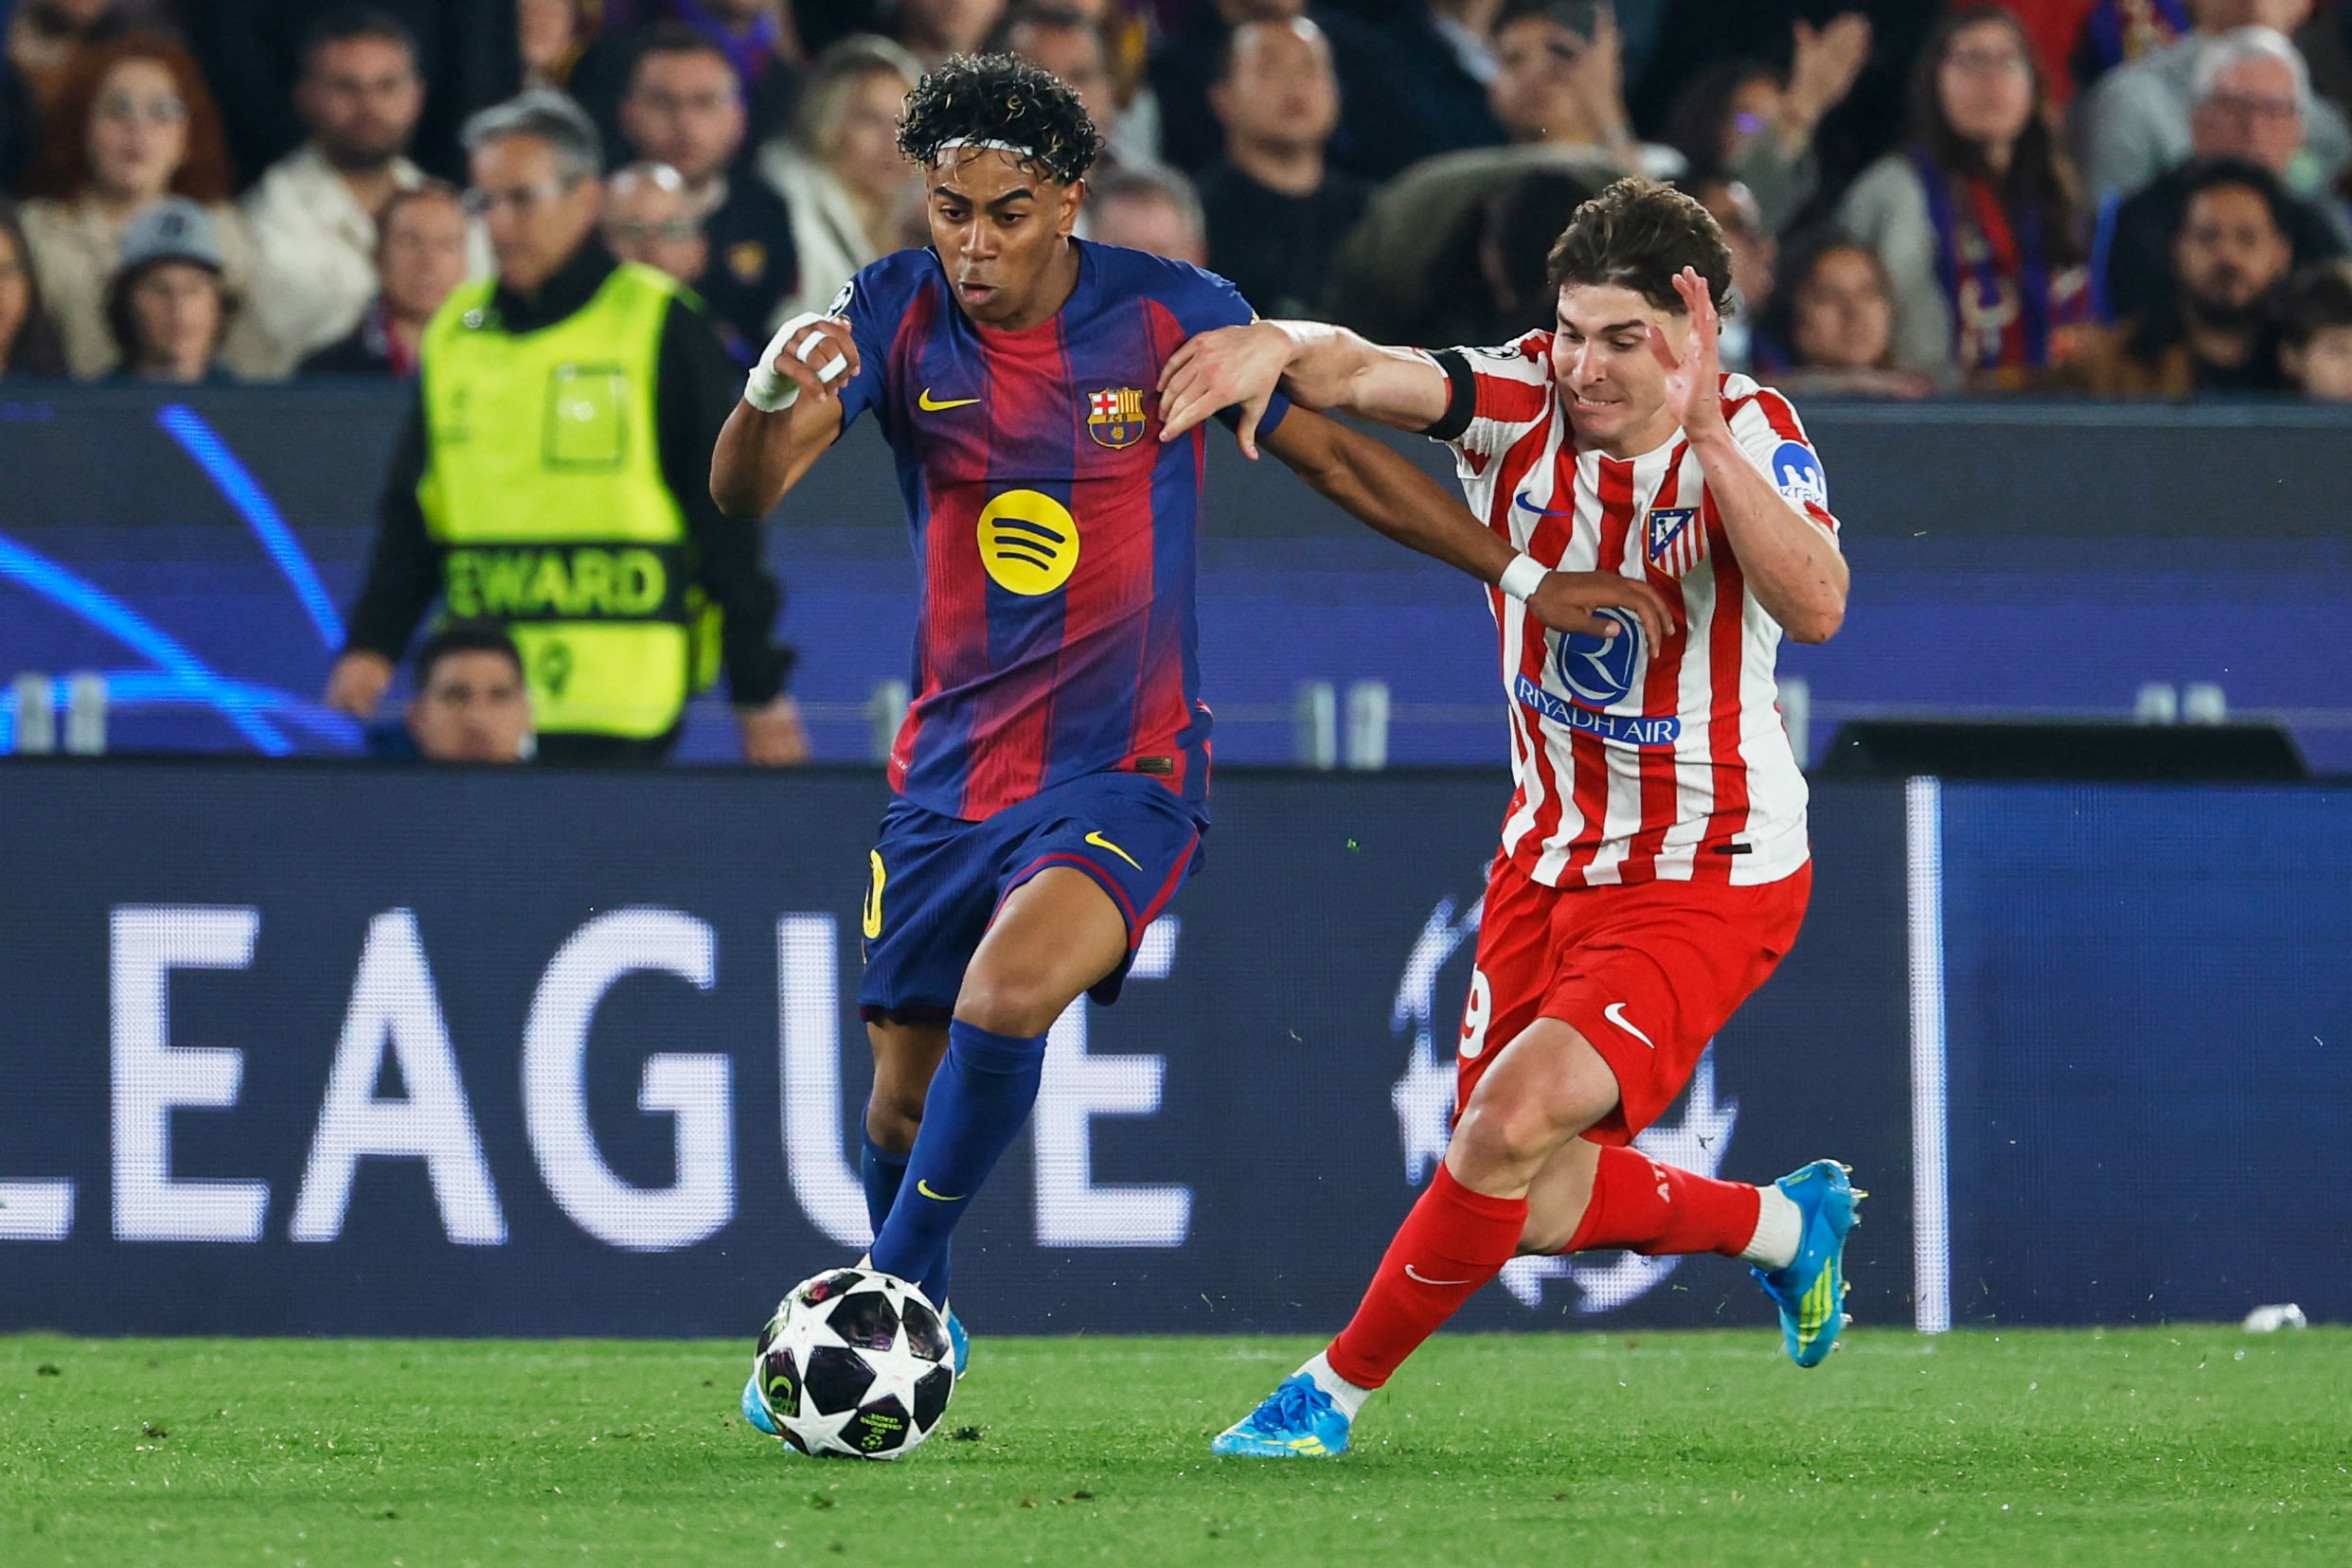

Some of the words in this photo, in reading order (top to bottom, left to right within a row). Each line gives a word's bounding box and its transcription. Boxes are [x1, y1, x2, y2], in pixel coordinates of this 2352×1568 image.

[1105, 414, 1128, 422] FCB
[1519, 677, 1615, 737] RIYADH
[1623, 721, 1673, 743] AIR
[1459, 963, 1491, 1060] 9
